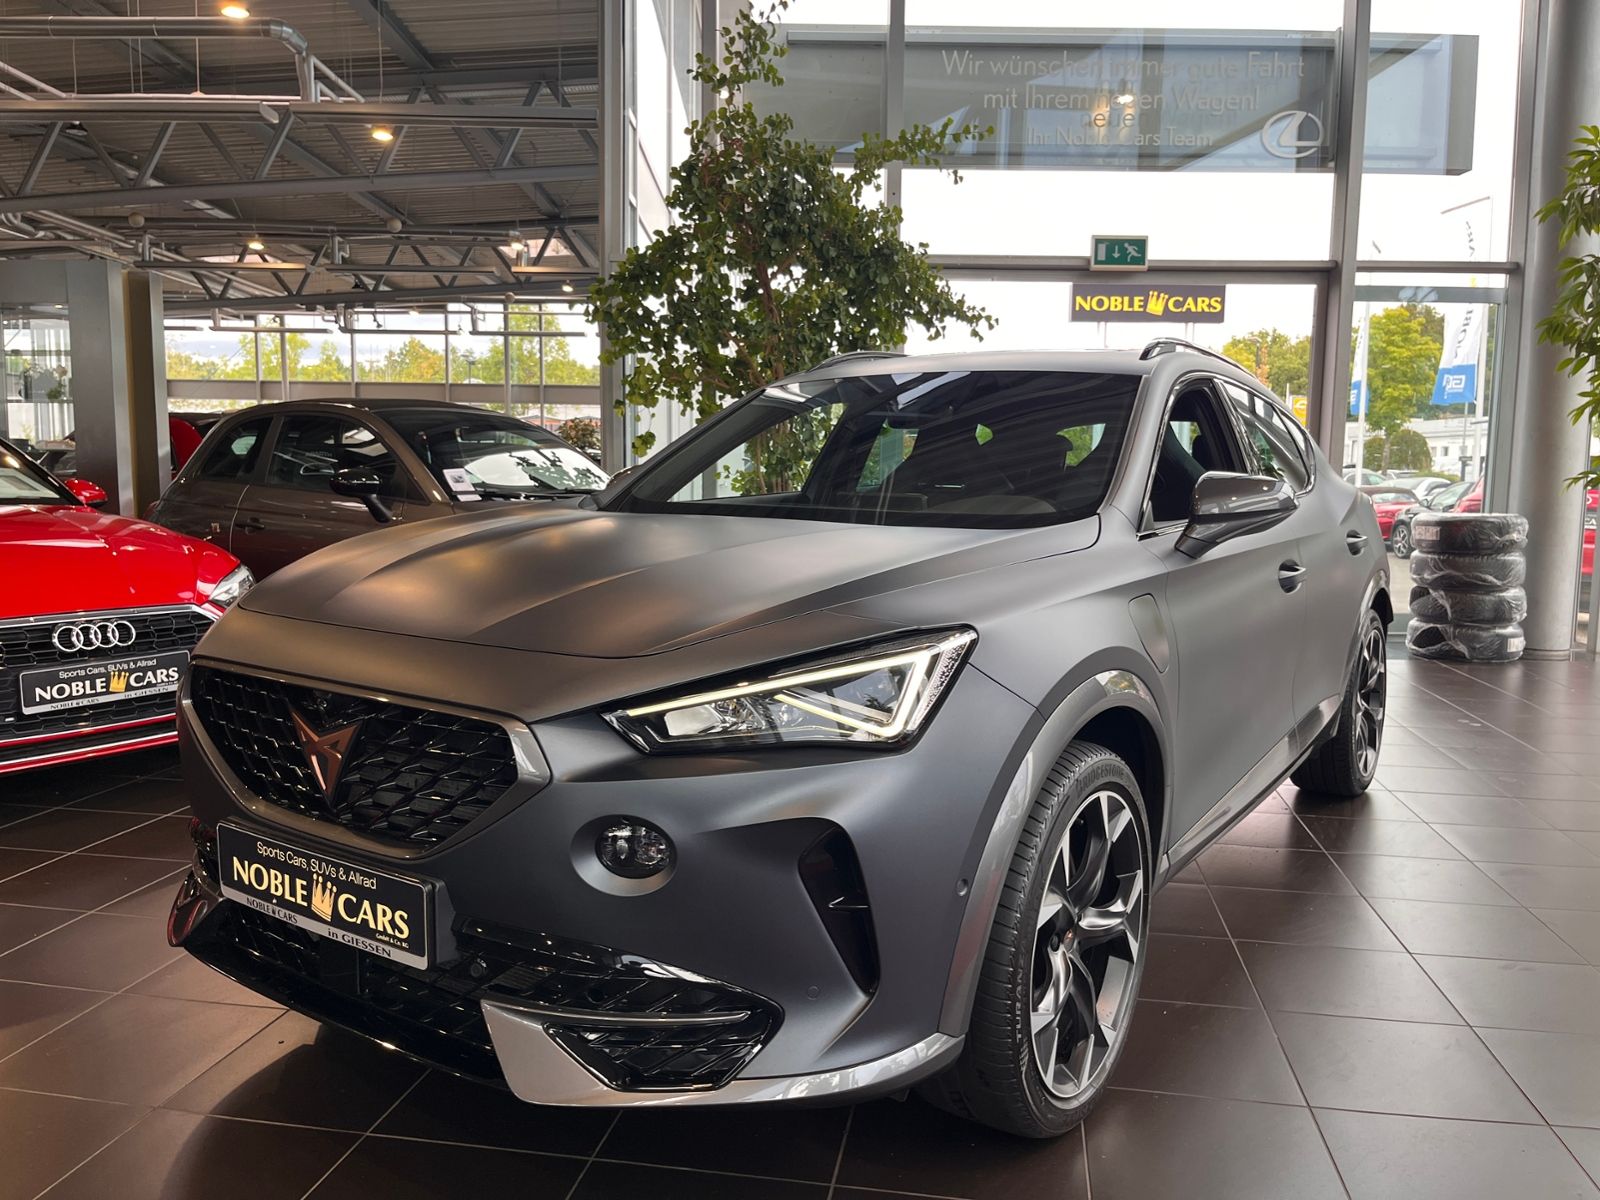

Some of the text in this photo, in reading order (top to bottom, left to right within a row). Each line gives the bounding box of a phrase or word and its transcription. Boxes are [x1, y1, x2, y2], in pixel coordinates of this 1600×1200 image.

[942, 50, 1305, 83] Wir wünschen immer gute Fahrt
[983, 87, 1018, 109] mit
[1025, 83, 1090, 109] Ihrem
[1173, 85, 1260, 115] Wagen!
[1028, 127, 1050, 146] Ihr
[1166, 126, 1214, 146] Team
[1075, 295, 1222, 313] NOBLE CARS
[59, 667, 86, 679] Sports
[108, 662, 128, 672] SUVs
[129, 660, 136, 669] &
[136, 658, 157, 668] Allrad
[35, 667, 179, 702] NOBLE CARS
[257, 841, 377, 890] Sports Cars, SUVs & Allrad
[233, 856, 410, 939] NOBLE CARS
[247, 896, 298, 924] NOBLE CARS
[328, 927, 392, 958] in GIESSEN
